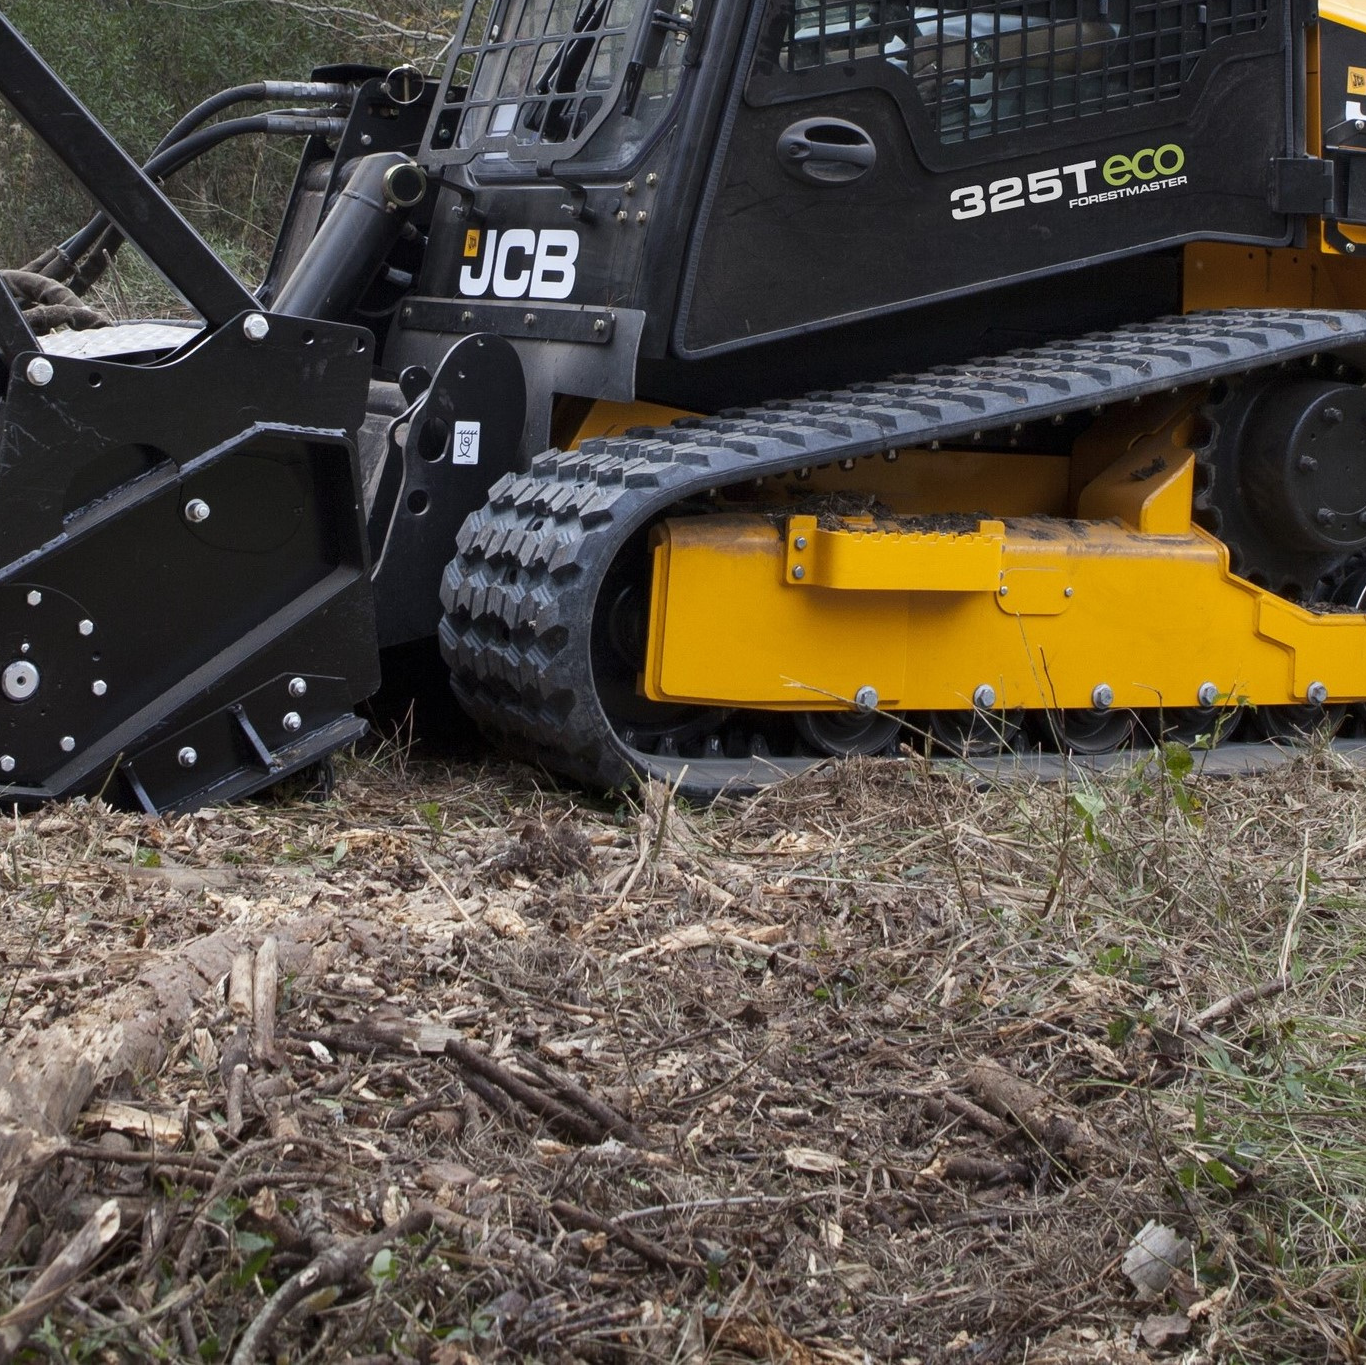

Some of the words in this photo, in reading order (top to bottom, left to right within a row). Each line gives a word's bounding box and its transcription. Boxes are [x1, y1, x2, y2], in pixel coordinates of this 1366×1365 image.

[950, 160, 1097, 220] 325T
[1103, 144, 1185, 186] eco
[1069, 176, 1188, 209] FORESTMASTER
[459, 229, 580, 299] JCB
